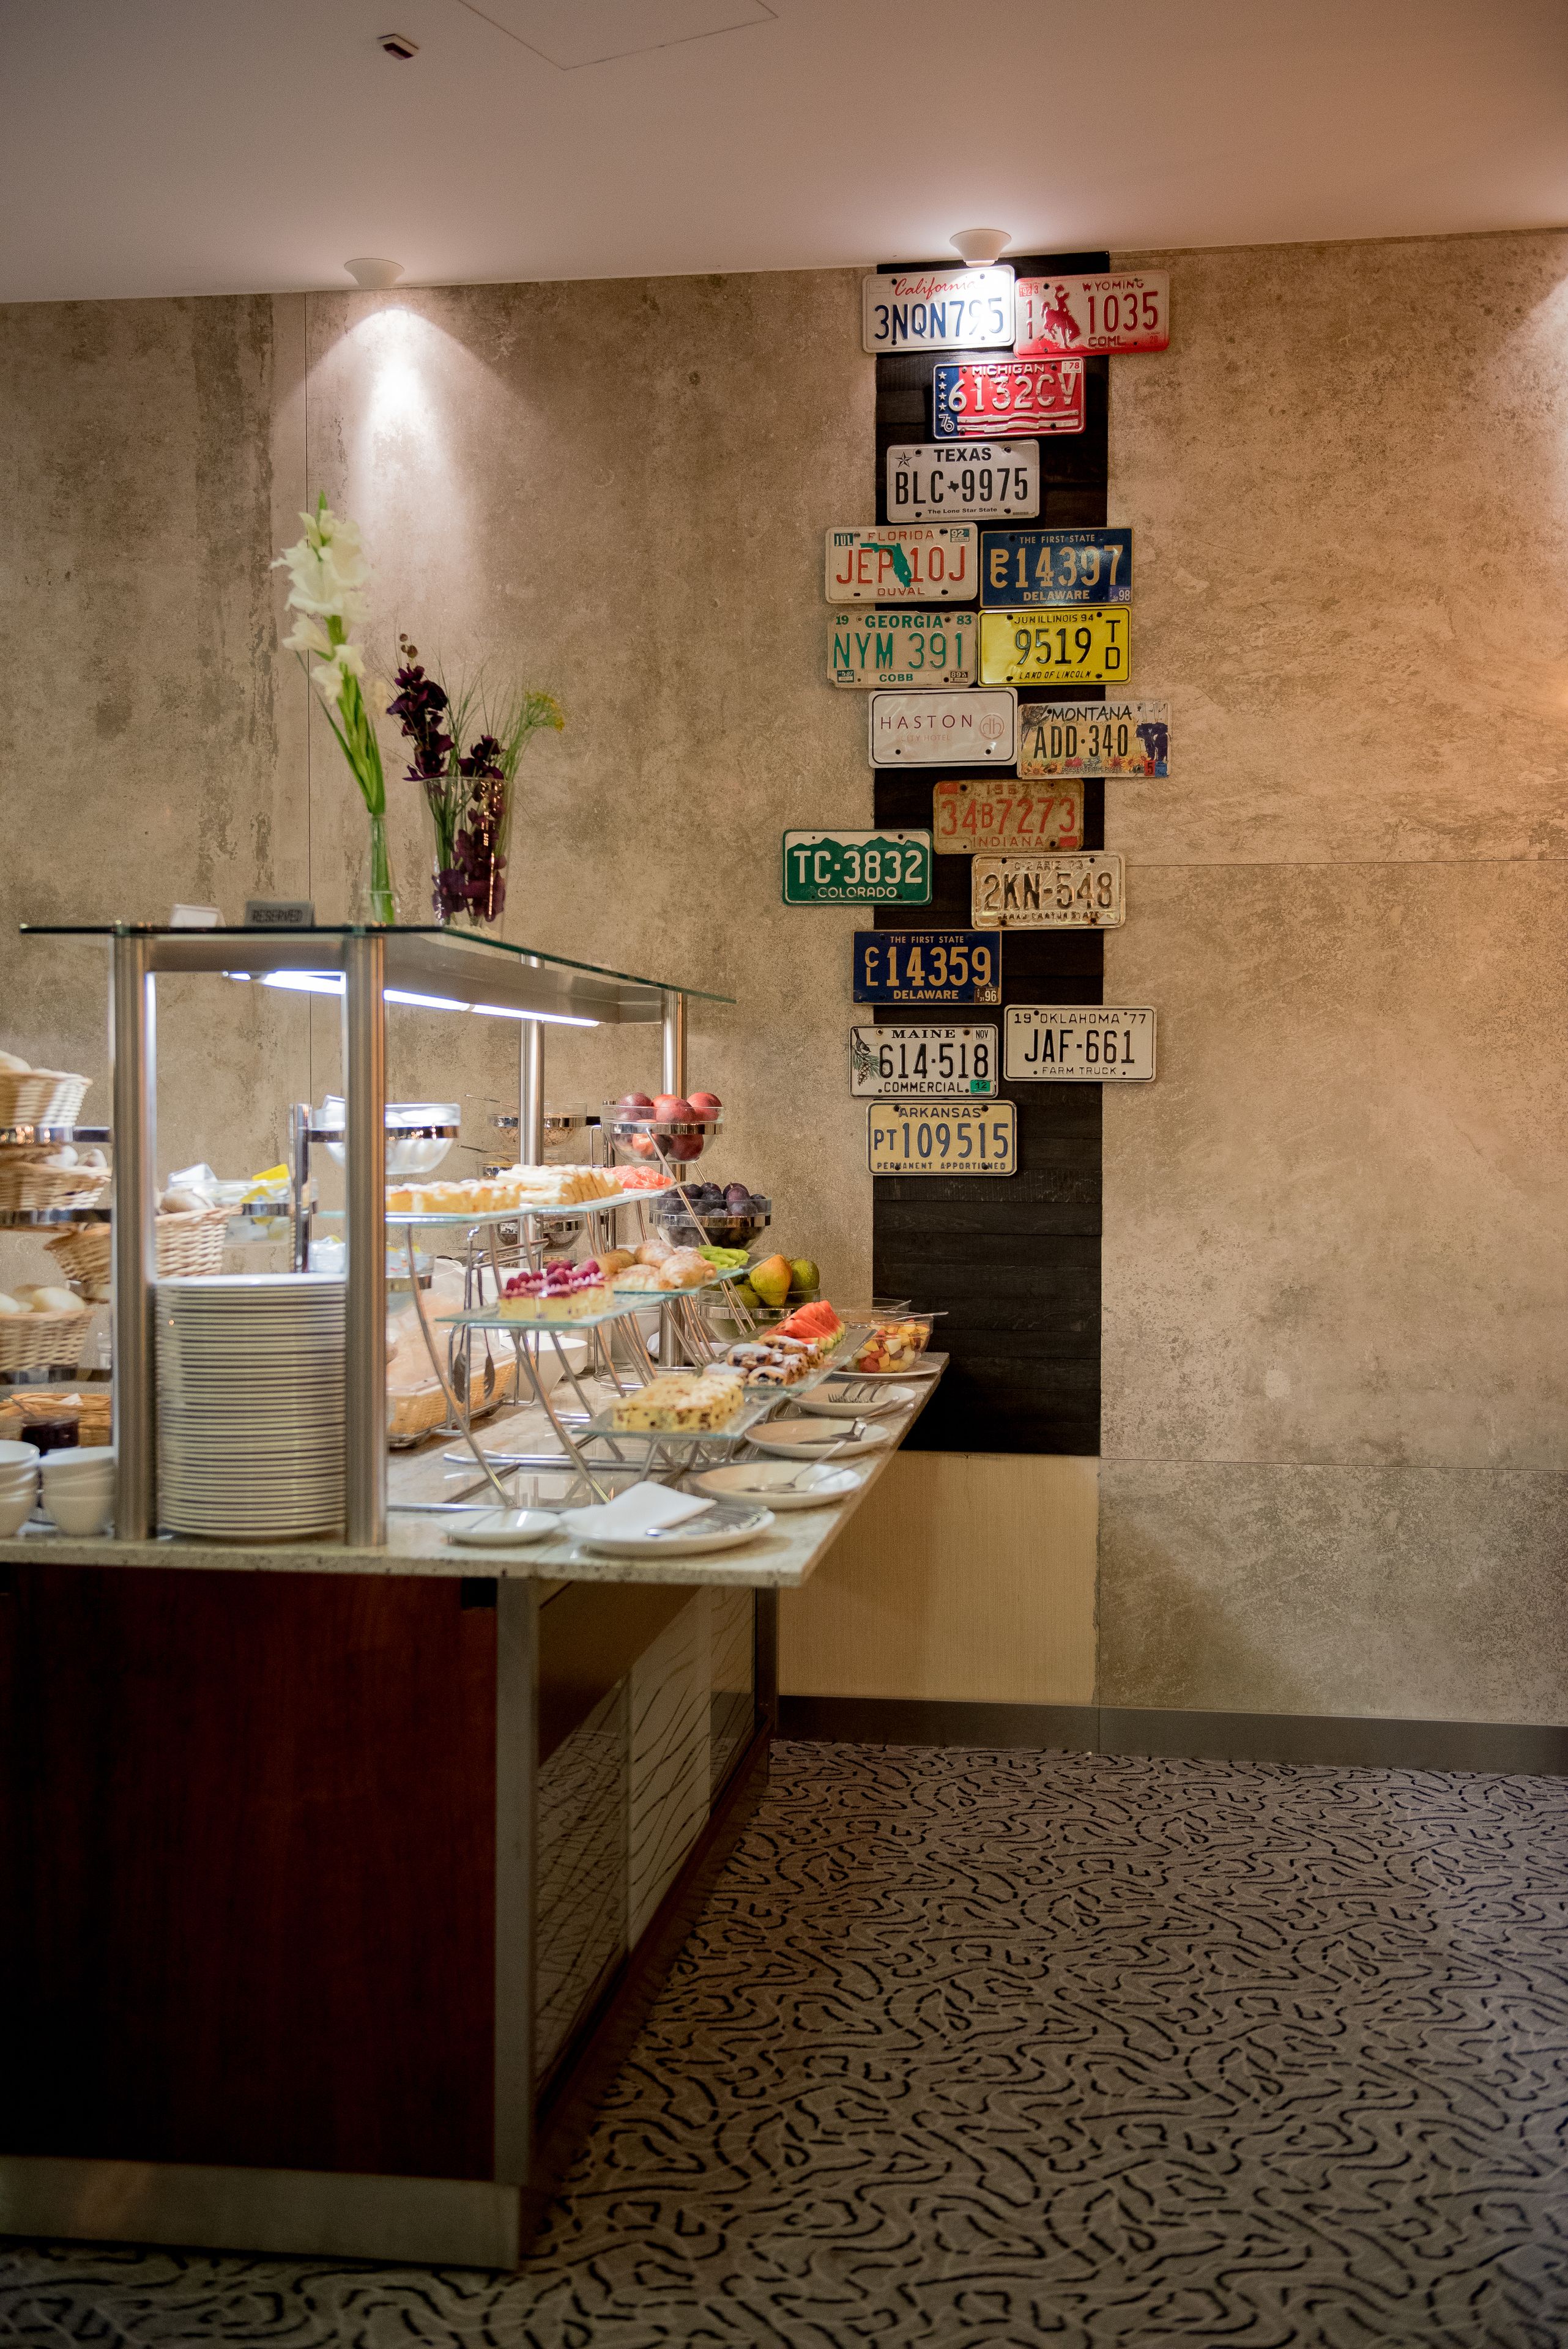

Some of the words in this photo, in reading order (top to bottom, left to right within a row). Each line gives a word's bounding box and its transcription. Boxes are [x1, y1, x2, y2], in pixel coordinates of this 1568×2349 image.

[894, 276, 977, 300] California
[1082, 278, 1144, 292] WYOMING
[1088, 291, 1158, 334] 1035
[874, 297, 1003, 341] 3NQN795
[1088, 336, 1126, 347] COML
[972, 364, 1045, 376] MICHIGAN
[948, 373, 1077, 412] 6132CV
[934, 447, 992, 462] TEXAS
[868, 530, 935, 541] FLORIDA
[951, 529, 964, 538] 92
[835, 535, 853, 546] JUL
[1015, 544, 1123, 588] 14397
[877, 587, 925, 596] DUVAL
[1023, 590, 1090, 601] DELAWARE
[1118, 590, 1131, 601] 98
[836, 615, 849, 625] 19
[865, 615, 943, 628] GEORGIA
[956, 615, 972, 625] 83
[1038, 614, 1077, 623] ILLINOIS
[833, 632, 893, 669] NYM
[908, 631, 962, 669] 391
[1015, 627, 1091, 665] 9519
[879, 674, 913, 682] COBB
[1051, 705, 1132, 722] MONTANA
[880, 714, 972, 730] HASTON
[973, 836, 1044, 847] INDIANA
[817, 887, 897, 898] COLORADO
[984, 872, 1112, 910] 2KN-548
[886, 946, 991, 987] 14359
[893, 990, 959, 1000] DELAWARE
[984, 990, 997, 1002] 96
[1014, 1013, 1031, 1023] 19
[1040, 1014, 1120, 1024] OKLAHOMA
[1129, 1014, 1146, 1024] 77
[891, 1029, 956, 1039] MAINE
[975, 1030, 989, 1039] NOV
[1024, 1028, 1135, 1064] JAF-661
[884, 1082, 963, 1093] COMMERCIAL
[899, 1107, 981, 1118] ARKANSAS
[902, 1123, 1008, 1159] 109515
